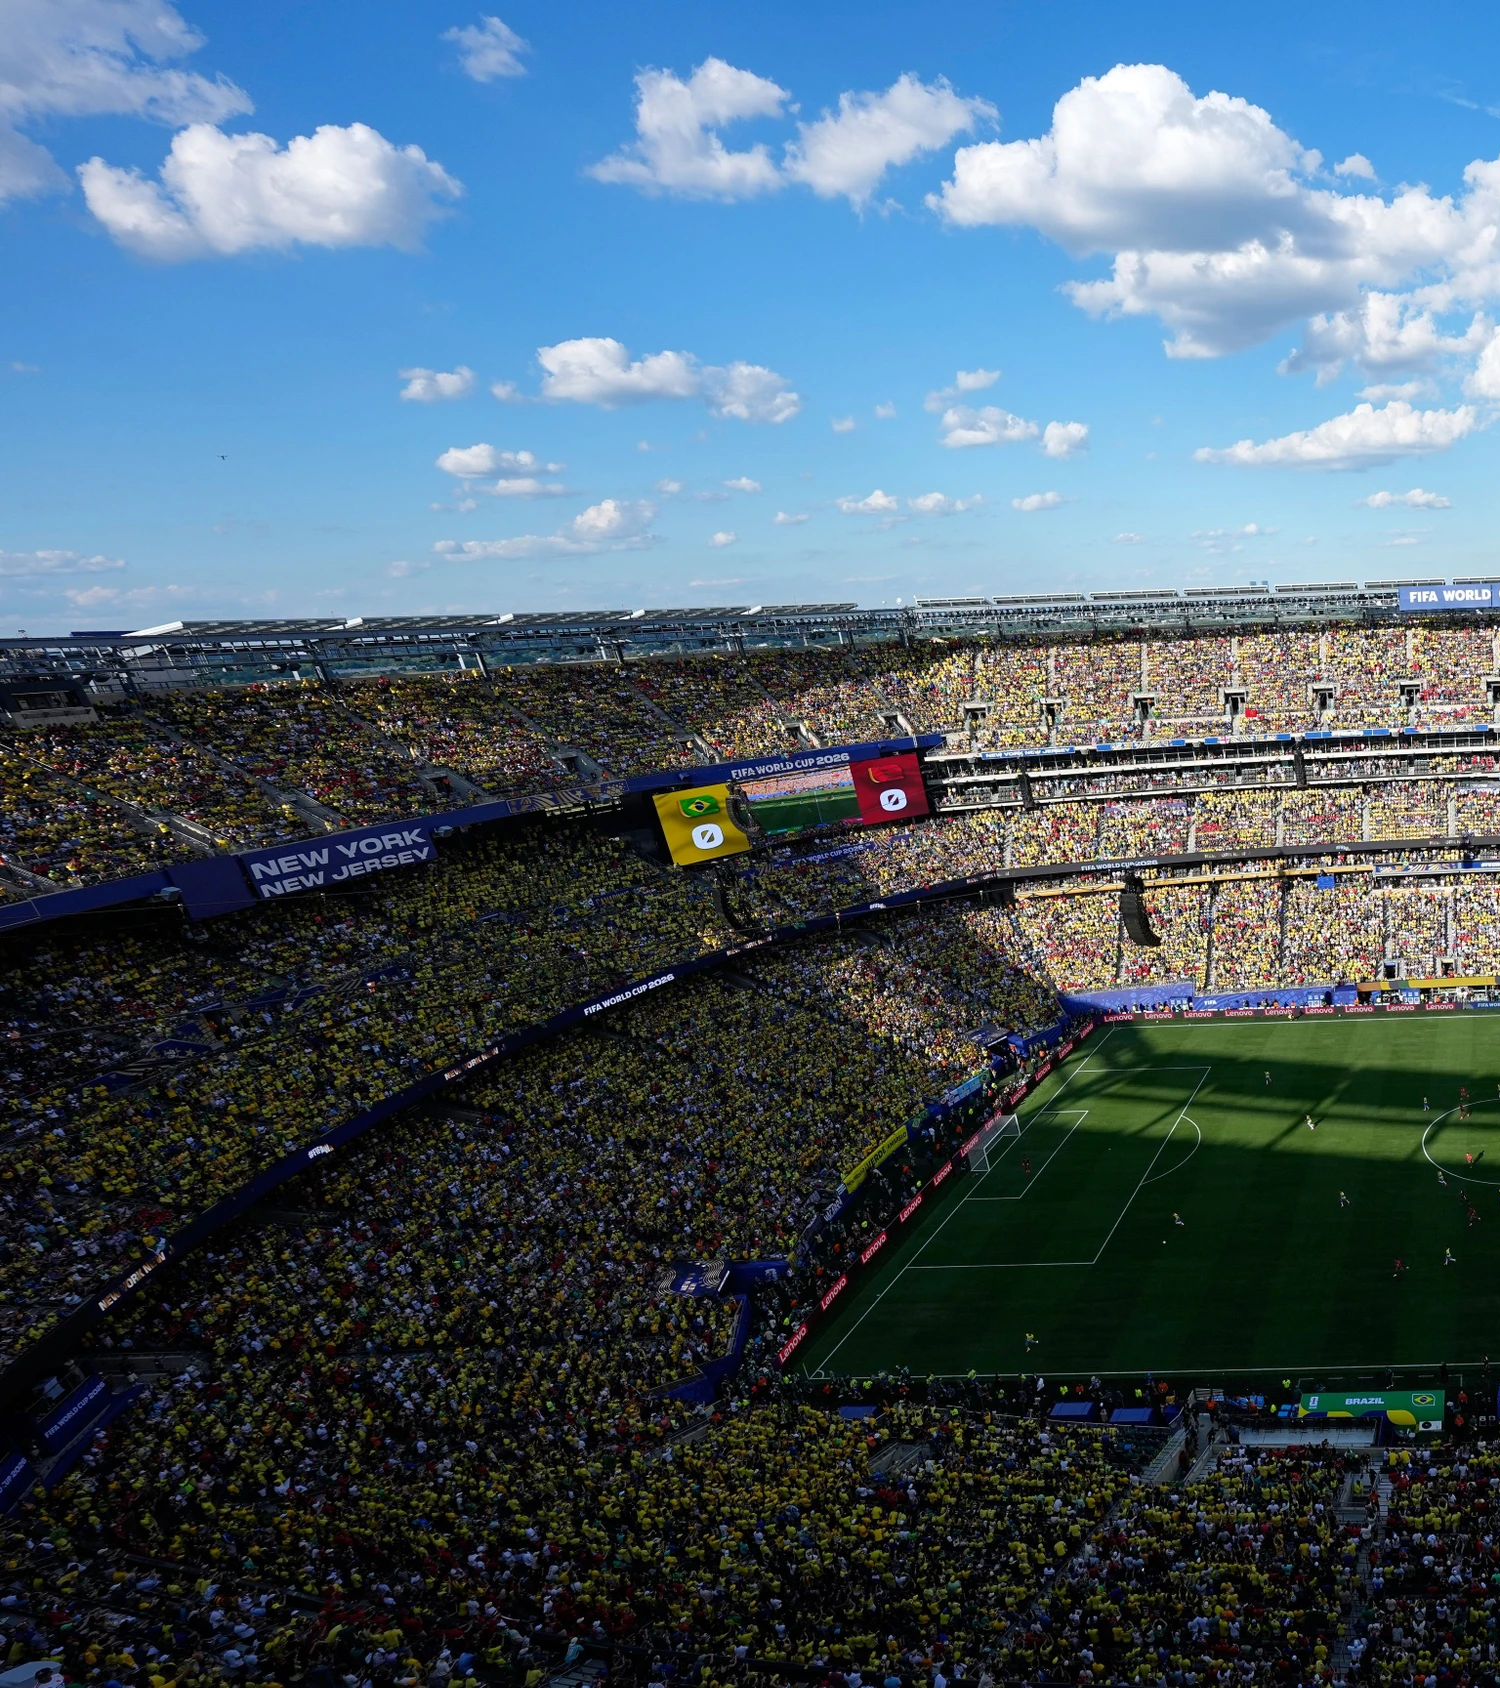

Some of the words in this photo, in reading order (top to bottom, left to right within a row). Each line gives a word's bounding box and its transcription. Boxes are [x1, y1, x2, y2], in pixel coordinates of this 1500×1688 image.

[1409, 591, 1438, 603] FIFA
[1443, 590, 1491, 602] WORLD
[731, 768, 755, 780] FIFA
[755, 761, 794, 776] WORLD
[795, 758, 816, 769] CUP
[816, 752, 850, 766] 2026
[251, 848, 329, 879] NEW
[336, 829, 427, 859] YORK
[260, 871, 324, 898] NEW
[332, 847, 429, 881] JERSEY
[584, 1003, 603, 1017] FIFA
[601, 991, 632, 1008] WORLD
[632, 984, 648, 996] CUP
[648, 973, 675, 990] 2026
[1035, 1064, 1051, 1081] Lenovo
[984, 1111, 1002, 1131] Lenvo
[960, 1136, 979, 1157] Lenovo
[899, 1195, 923, 1223] Lenovo
[861, 1233, 887, 1264] Lenovo
[98, 1290, 121, 1312] NEW
[821, 1277, 847, 1310] Lenovo
[779, 1326, 808, 1363] Lenovo
[1345, 1397, 1384, 1405] BRAZIL
[44, 1425, 60, 1438] FIFA
[57, 1407, 79, 1427] WORLD
[77, 1396, 89, 1409] CUP
